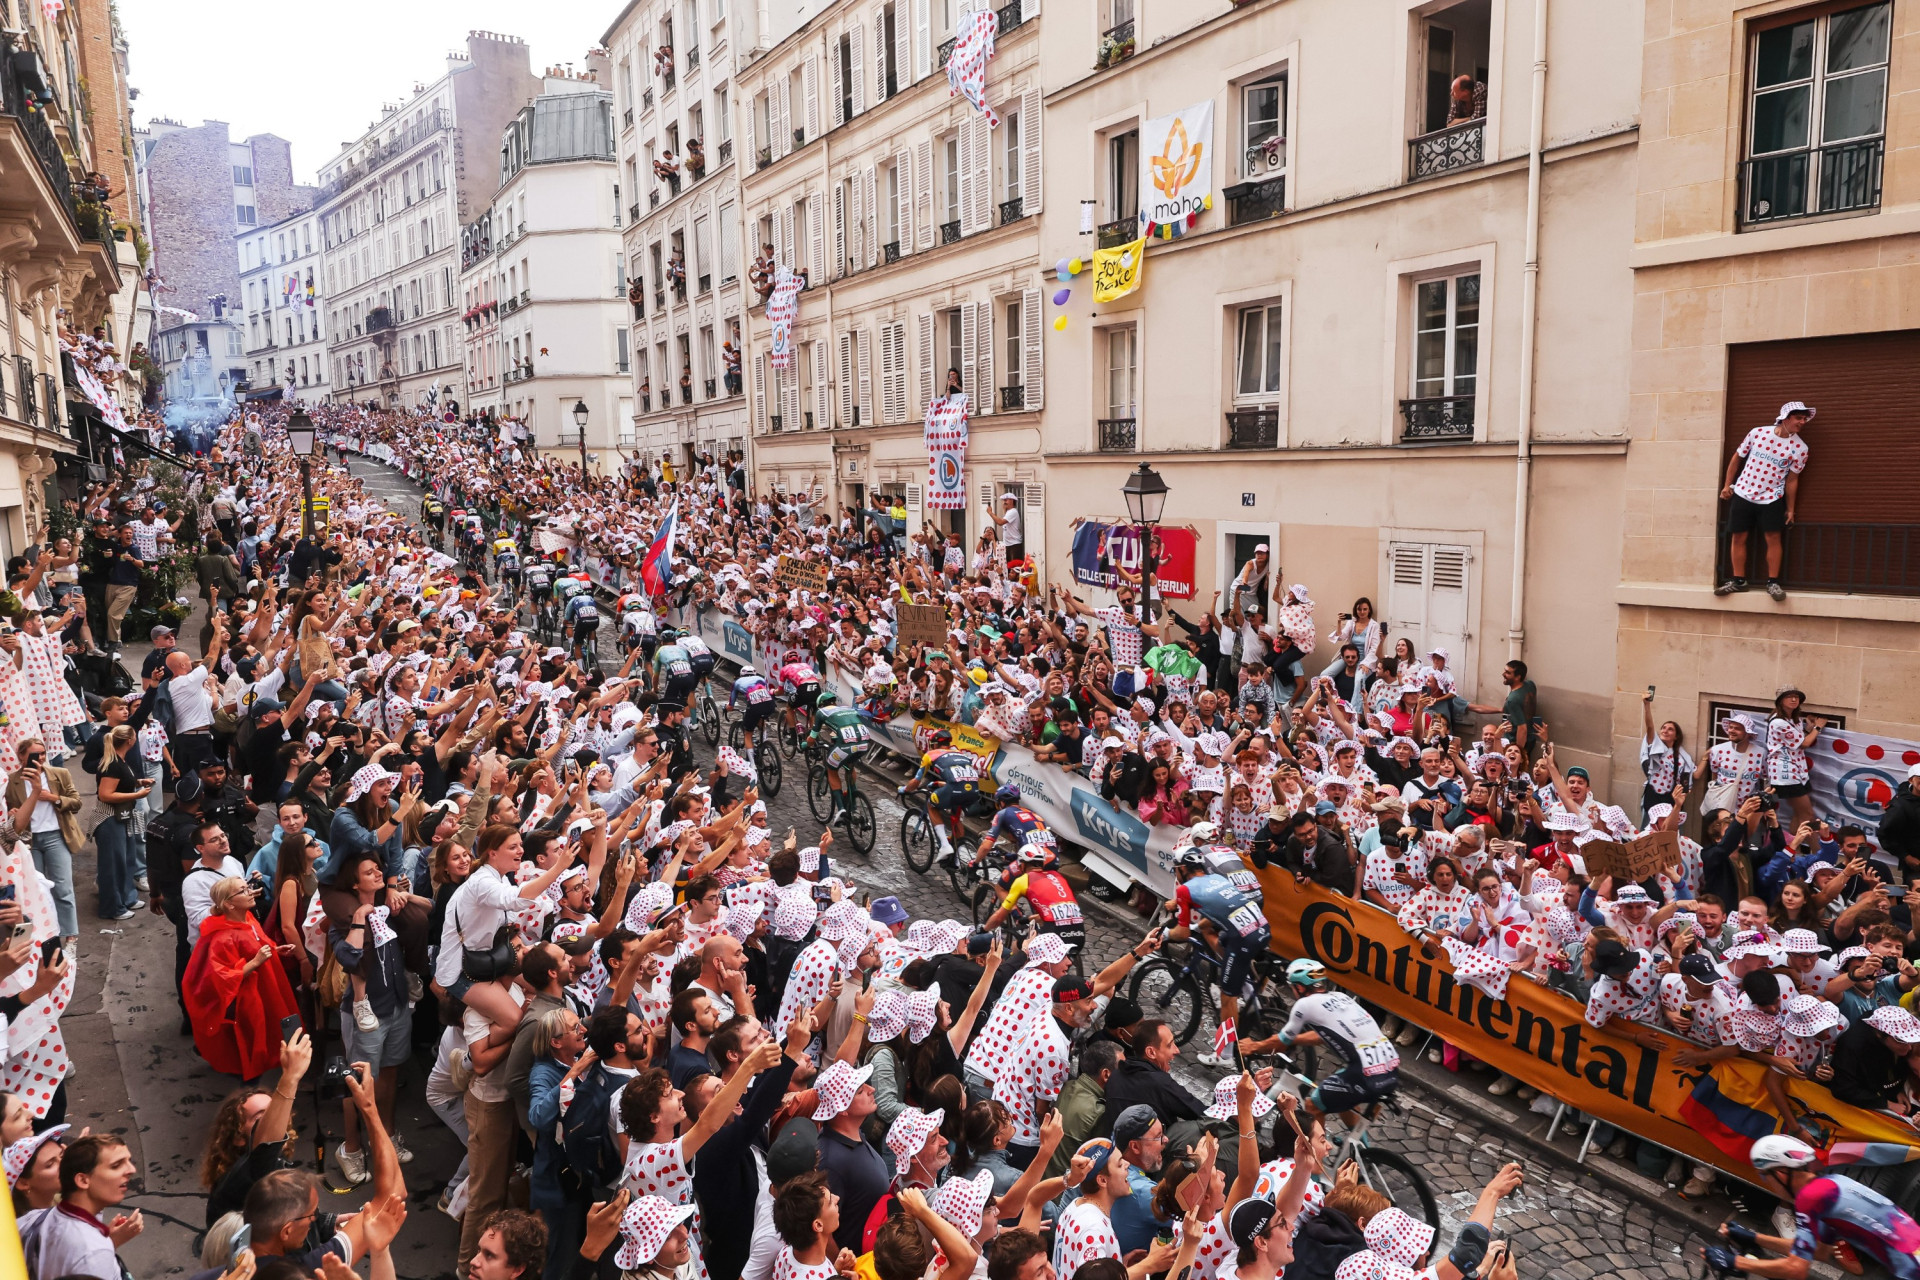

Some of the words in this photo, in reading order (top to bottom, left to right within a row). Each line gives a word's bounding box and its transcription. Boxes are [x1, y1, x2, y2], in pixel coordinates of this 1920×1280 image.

[1155, 196, 1202, 219] maho
[1243, 494, 1254, 506] 74
[1077, 567, 1116, 586] COLLECTIF
[1157, 578, 1190, 596] EBRUN
[727, 626, 748, 652] Krys
[806, 684, 818, 692] EF
[959, 732, 984, 748] France
[1008, 766, 1045, 792] OPTIQUE
[1017, 783, 1055, 807] AUDITION
[1028, 831, 1043, 843] 194
[1081, 801, 1133, 852] Krys
[1604, 836, 1654, 856] ALLEZ
[1609, 860, 1660, 880] PINOT
[1052, 903, 1069, 919] 162
[1235, 911, 1251, 927] 98
[1300, 902, 1659, 1114] Continental
[1247, 1217, 1268, 1241] FAEMA
